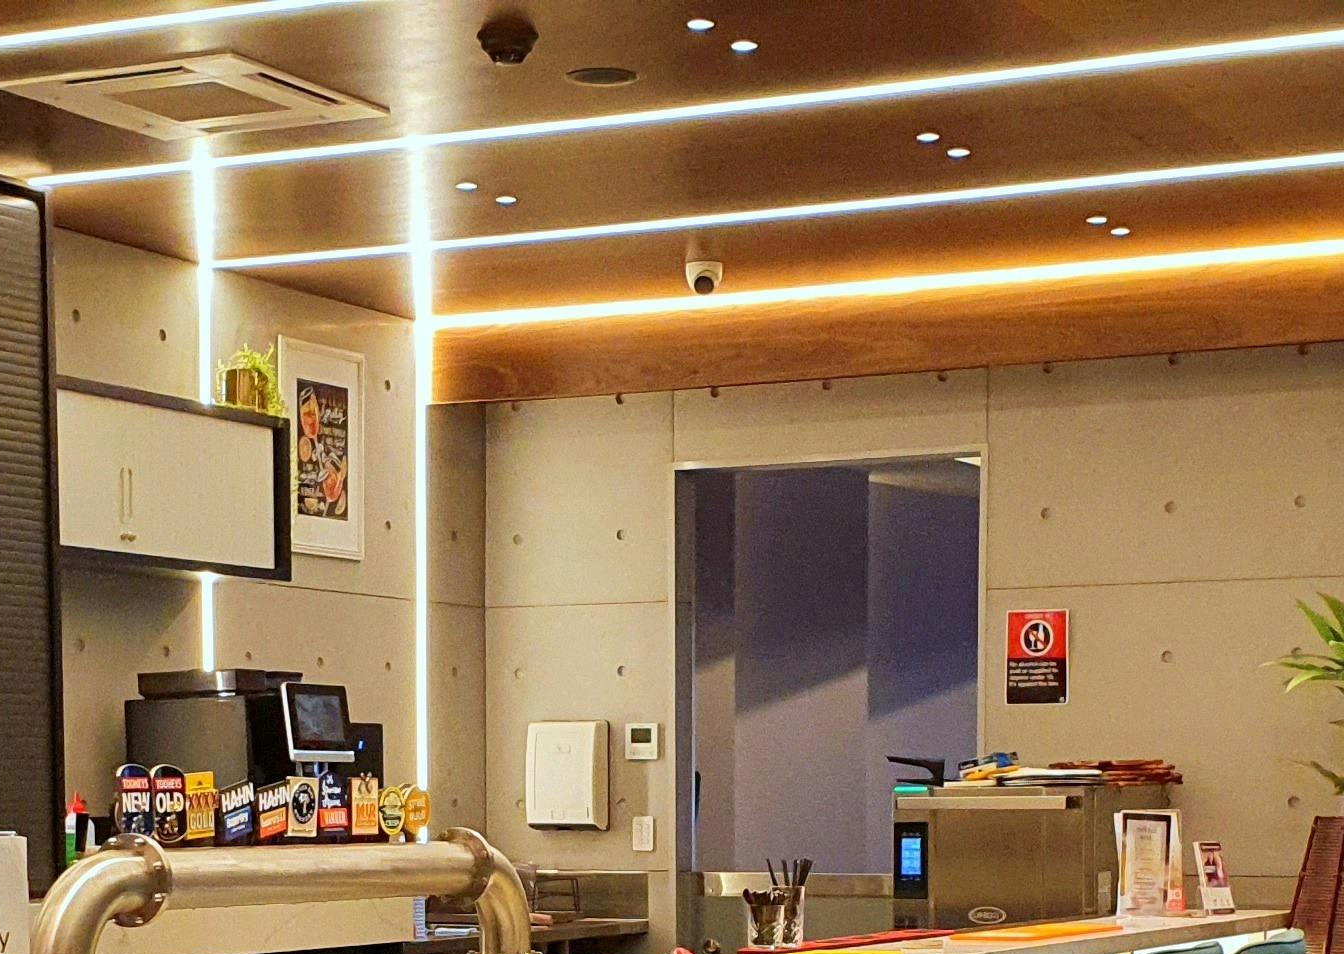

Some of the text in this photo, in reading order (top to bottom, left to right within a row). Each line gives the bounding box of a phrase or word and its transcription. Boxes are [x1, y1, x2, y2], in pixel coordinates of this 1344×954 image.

[122, 792, 150, 813] NEW
[156, 792, 184, 813] OLD
[221, 782, 254, 813] HAHN
[258, 785, 290, 812] HAHN
[190, 810, 215, 831] GOLD
